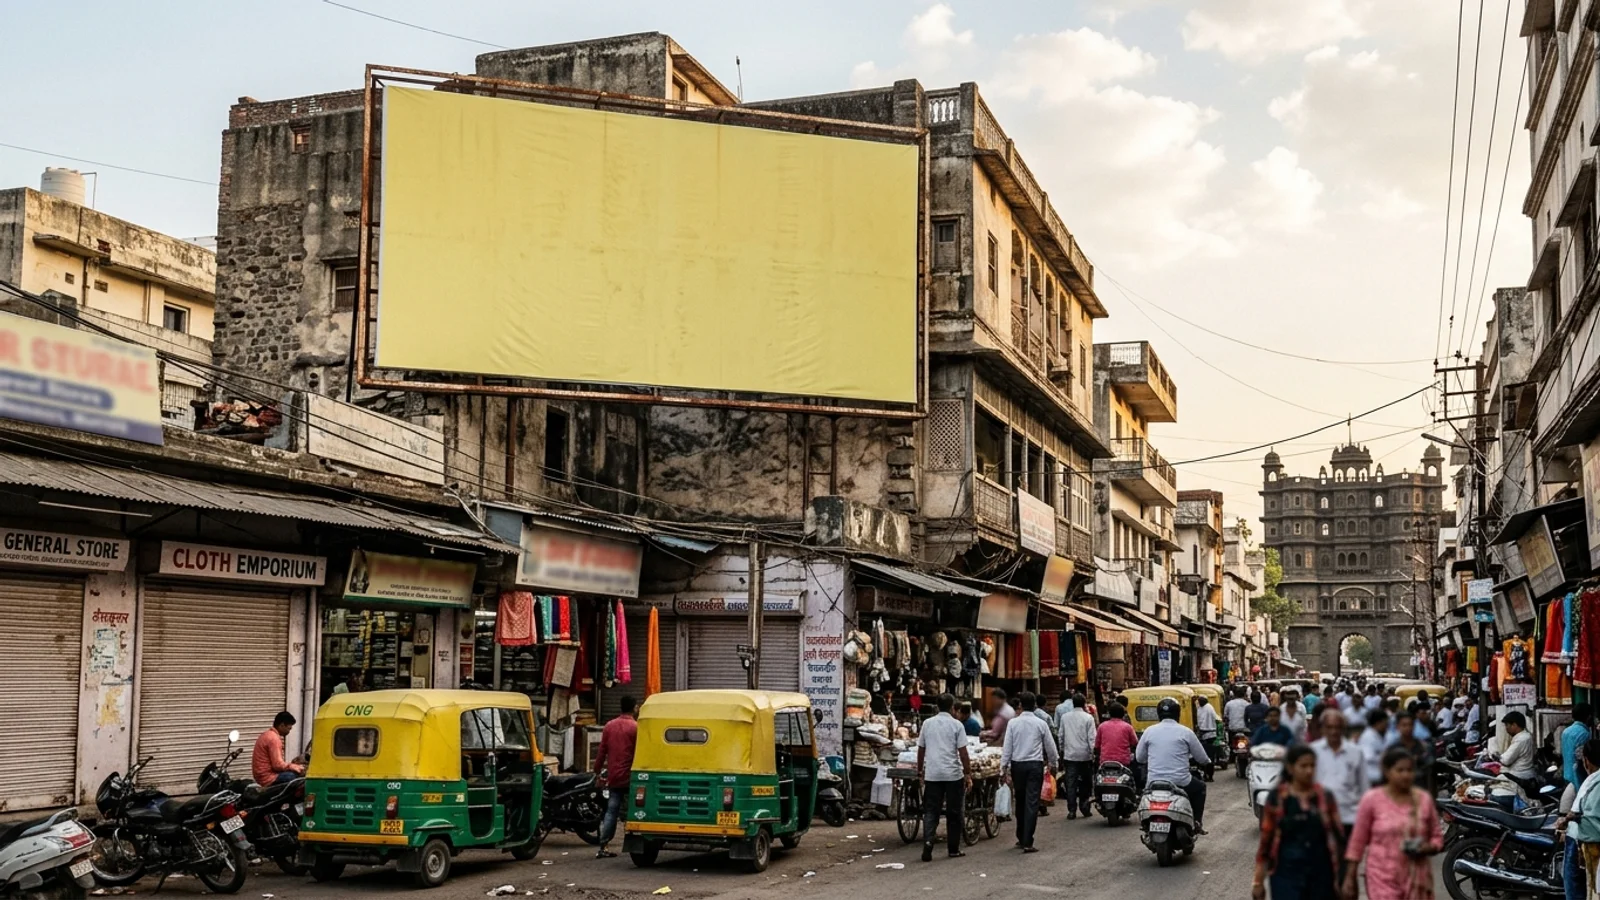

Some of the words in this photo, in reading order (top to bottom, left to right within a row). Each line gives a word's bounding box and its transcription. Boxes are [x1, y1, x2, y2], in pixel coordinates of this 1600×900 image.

[4, 532, 71, 555] GENERAL
[76, 539, 120, 559] STORE
[172, 547, 231, 572] CLOTH
[236, 558, 317, 580] EMPORIUM
[344, 704, 374, 717] CNG
